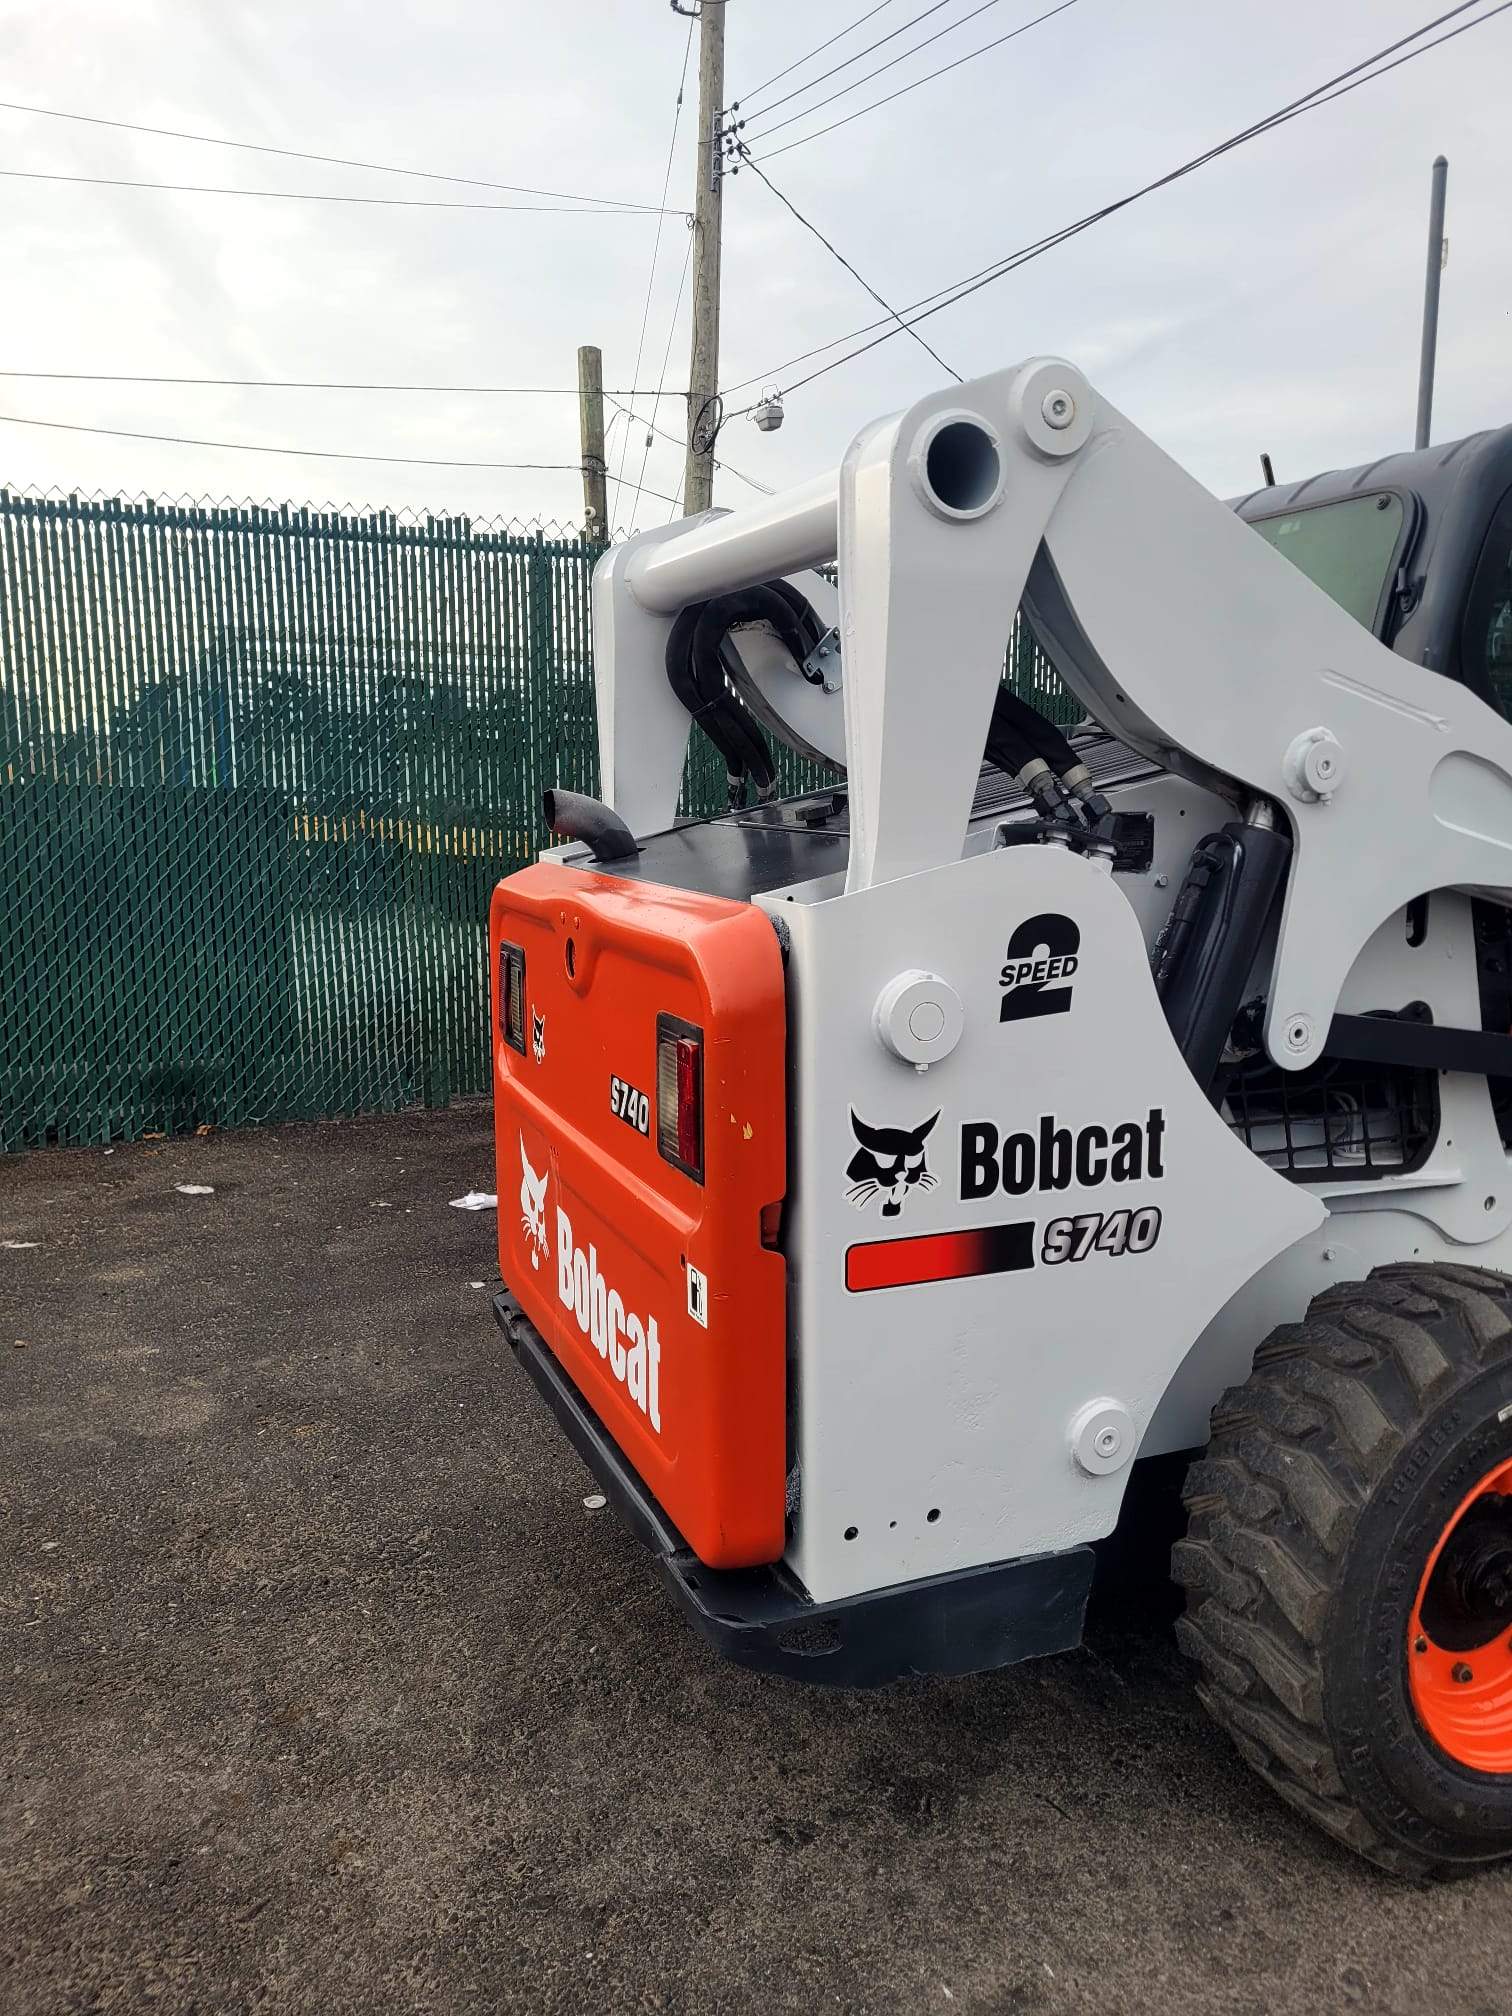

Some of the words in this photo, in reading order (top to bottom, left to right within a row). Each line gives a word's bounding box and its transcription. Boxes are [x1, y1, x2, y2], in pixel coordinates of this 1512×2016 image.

[999, 913, 1081, 1023] 2
[999, 956, 1078, 986] SPEED
[610, 1076, 650, 1134] S740
[959, 1108, 1166, 1201] Bobcat
[1041, 1206, 1162, 1265] S740
[557, 1205, 661, 1434] Bobcat
